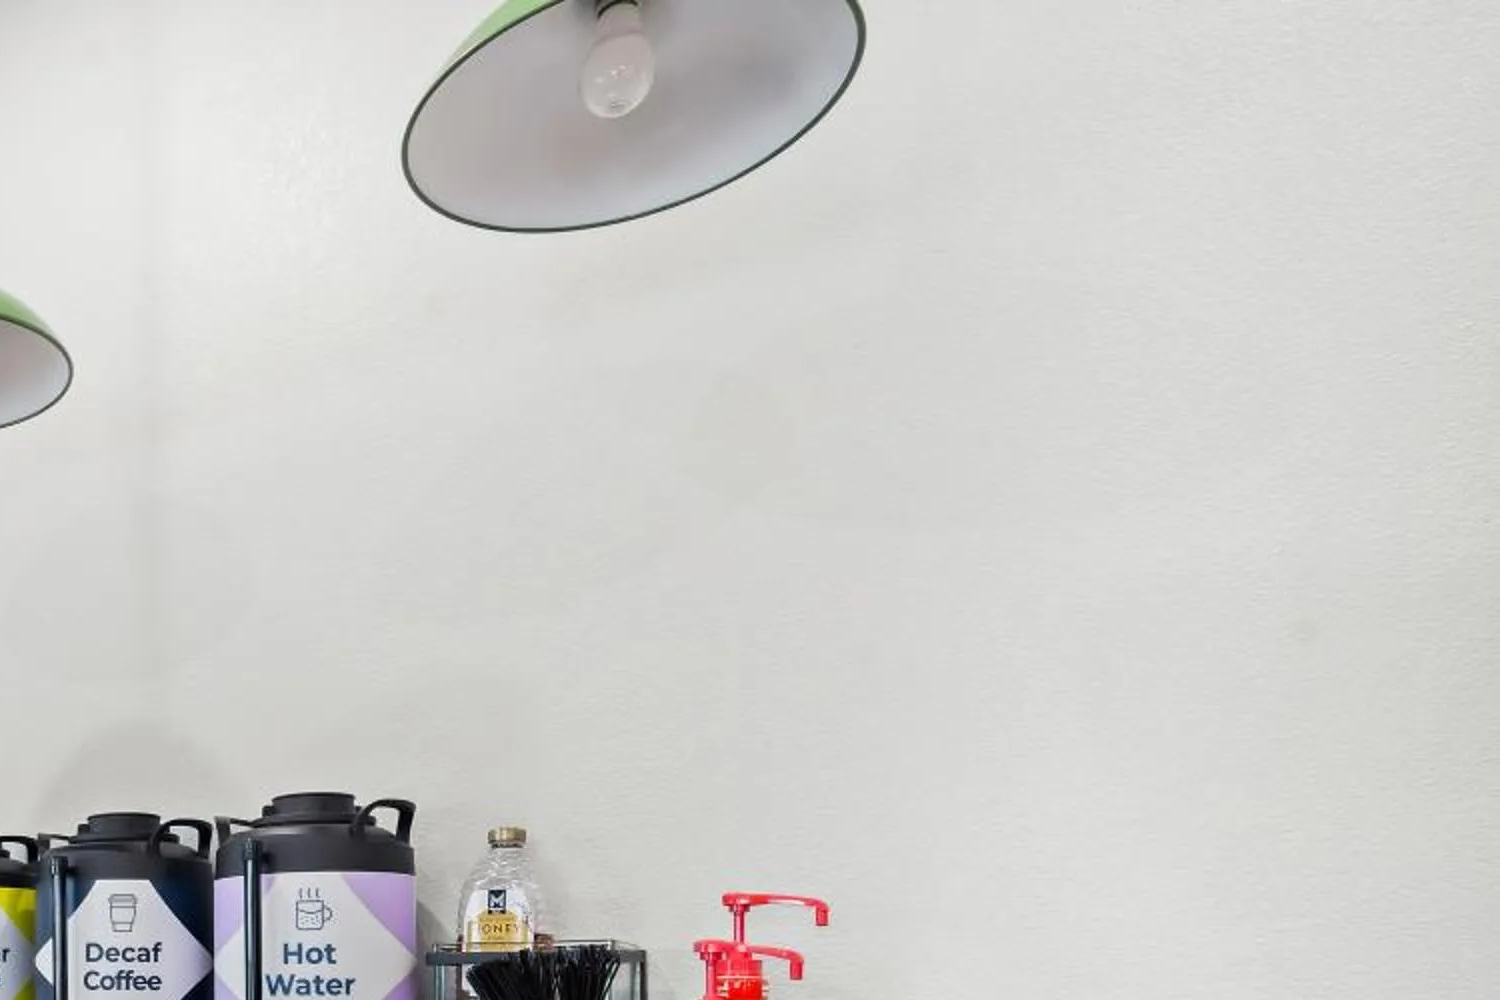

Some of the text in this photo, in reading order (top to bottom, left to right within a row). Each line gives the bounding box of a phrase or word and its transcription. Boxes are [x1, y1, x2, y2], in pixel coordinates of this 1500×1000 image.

[85, 942, 162, 962] Decaf
[283, 943, 337, 964] Hot
[83, 969, 163, 990] Coffee
[265, 973, 356, 996] Water
